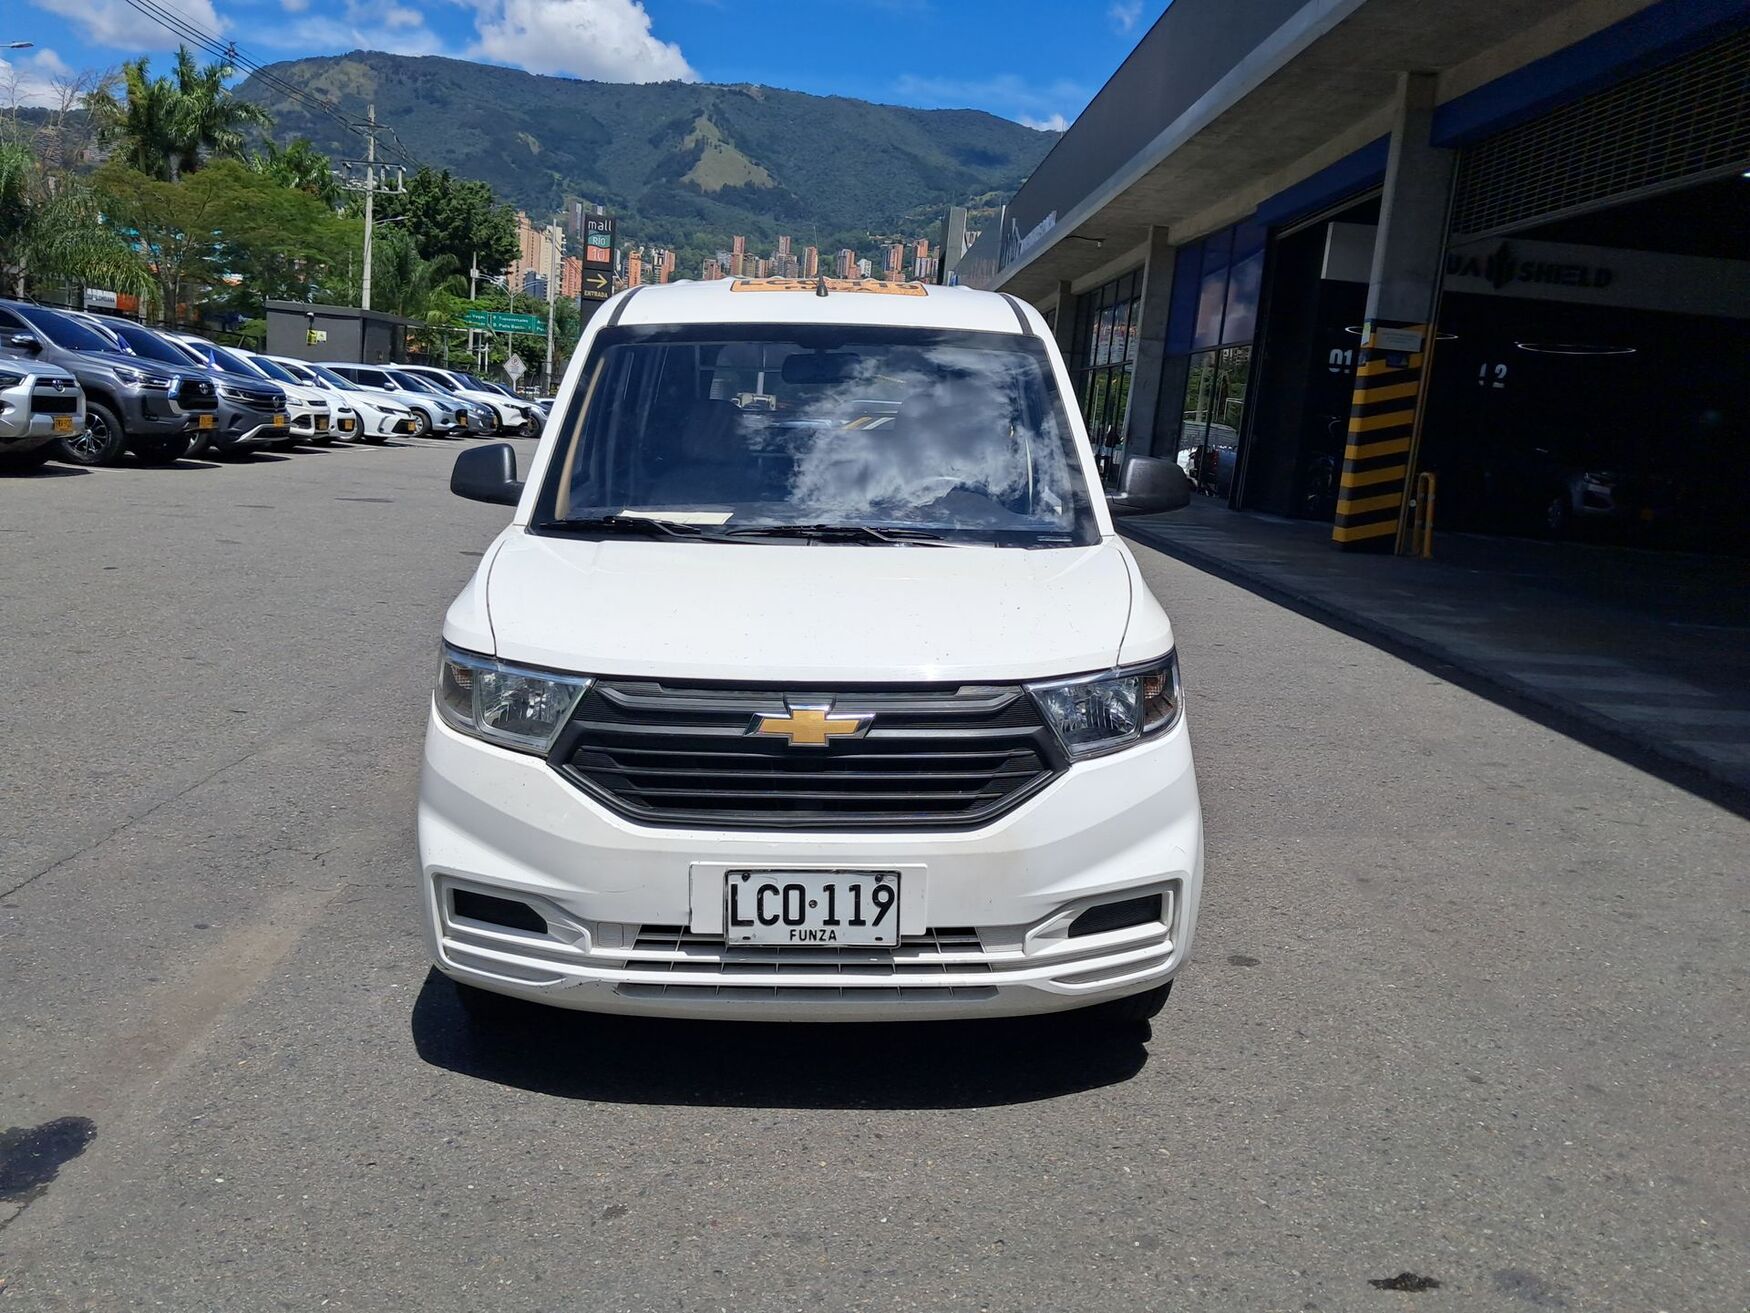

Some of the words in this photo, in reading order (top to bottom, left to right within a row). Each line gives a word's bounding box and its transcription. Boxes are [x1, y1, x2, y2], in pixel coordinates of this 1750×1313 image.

[588, 220, 612, 232] mall
[1518, 260, 1613, 288] SHIELD
[1328, 348, 1353, 374] 01
[788, 928, 838, 942] FUNZA
